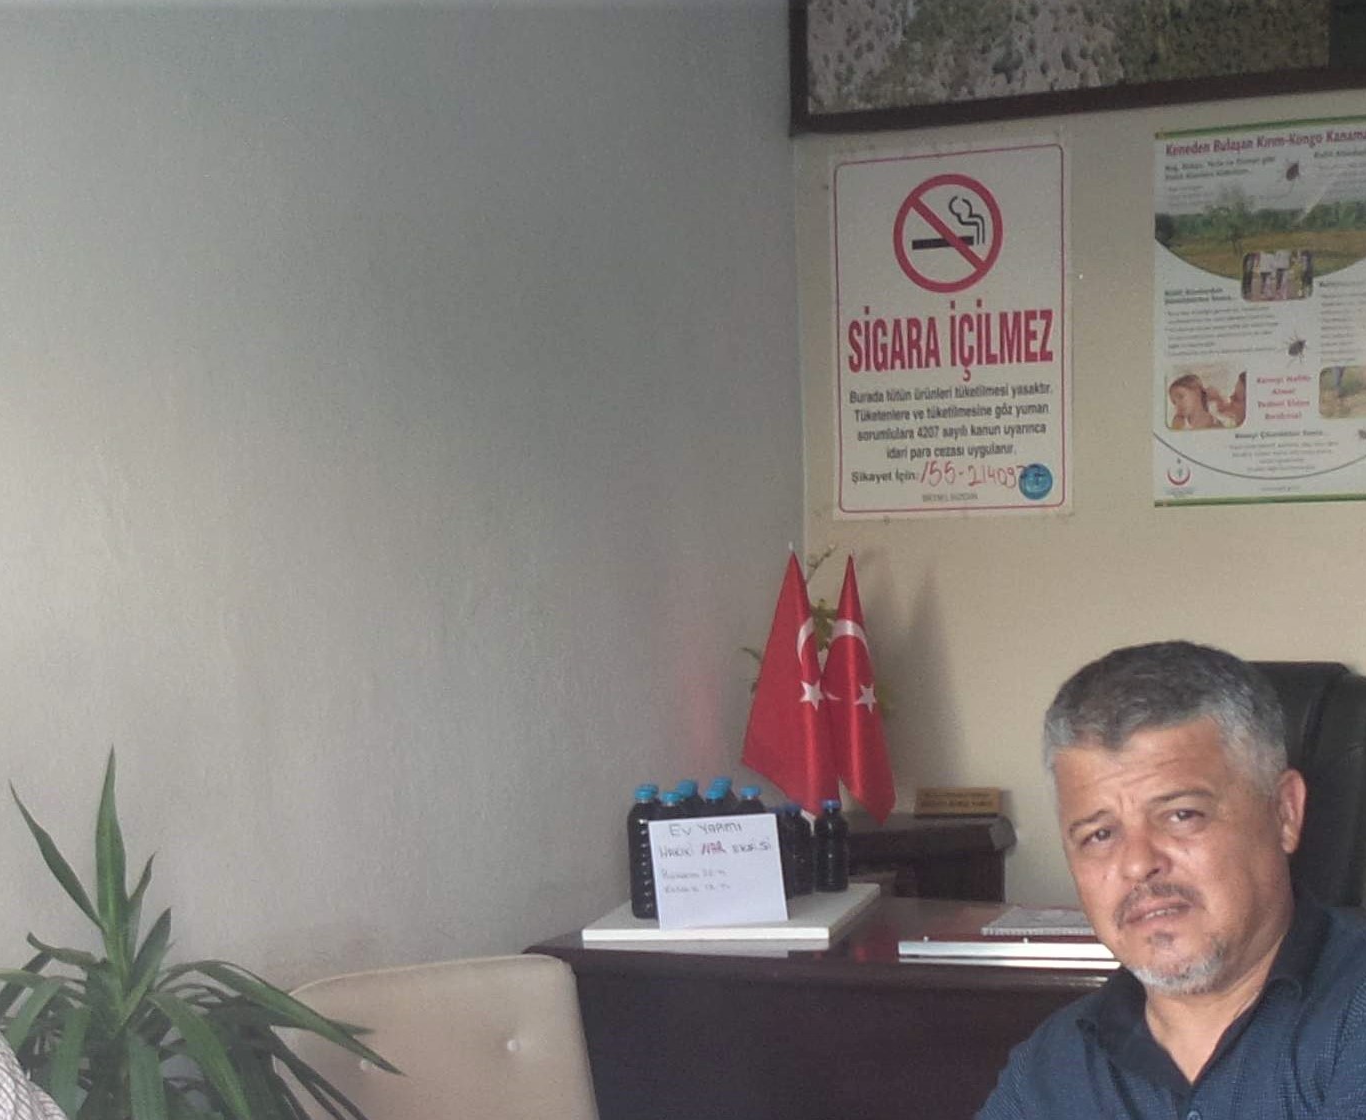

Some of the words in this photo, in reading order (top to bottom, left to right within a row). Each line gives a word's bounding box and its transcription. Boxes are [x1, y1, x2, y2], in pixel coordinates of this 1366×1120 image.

[848, 305, 941, 373] SİGARA
[949, 298, 1054, 382] İÇİLMEZ
[849, 389, 884, 404] Burada
[914, 387, 953, 401] ürünleri
[955, 384, 1009, 399] tüketilmesi
[854, 407, 911, 422] Tüketenlere
[912, 410, 925, 420] ve
[926, 404, 993, 419] tüketilmesine
[994, 403, 1013, 419] göz
[1015, 403, 1049, 418] yuman
[857, 427, 914, 441] sorumlulara
[916, 425, 940, 439] 4207
[970, 423, 1001, 436] kanun
[1003, 422, 1047, 438] uyarınca
[886, 445, 908, 460] idari
[910, 446, 932, 461] para
[933, 444, 965, 458] cezası
[850, 470, 892, 484] Şikayet
